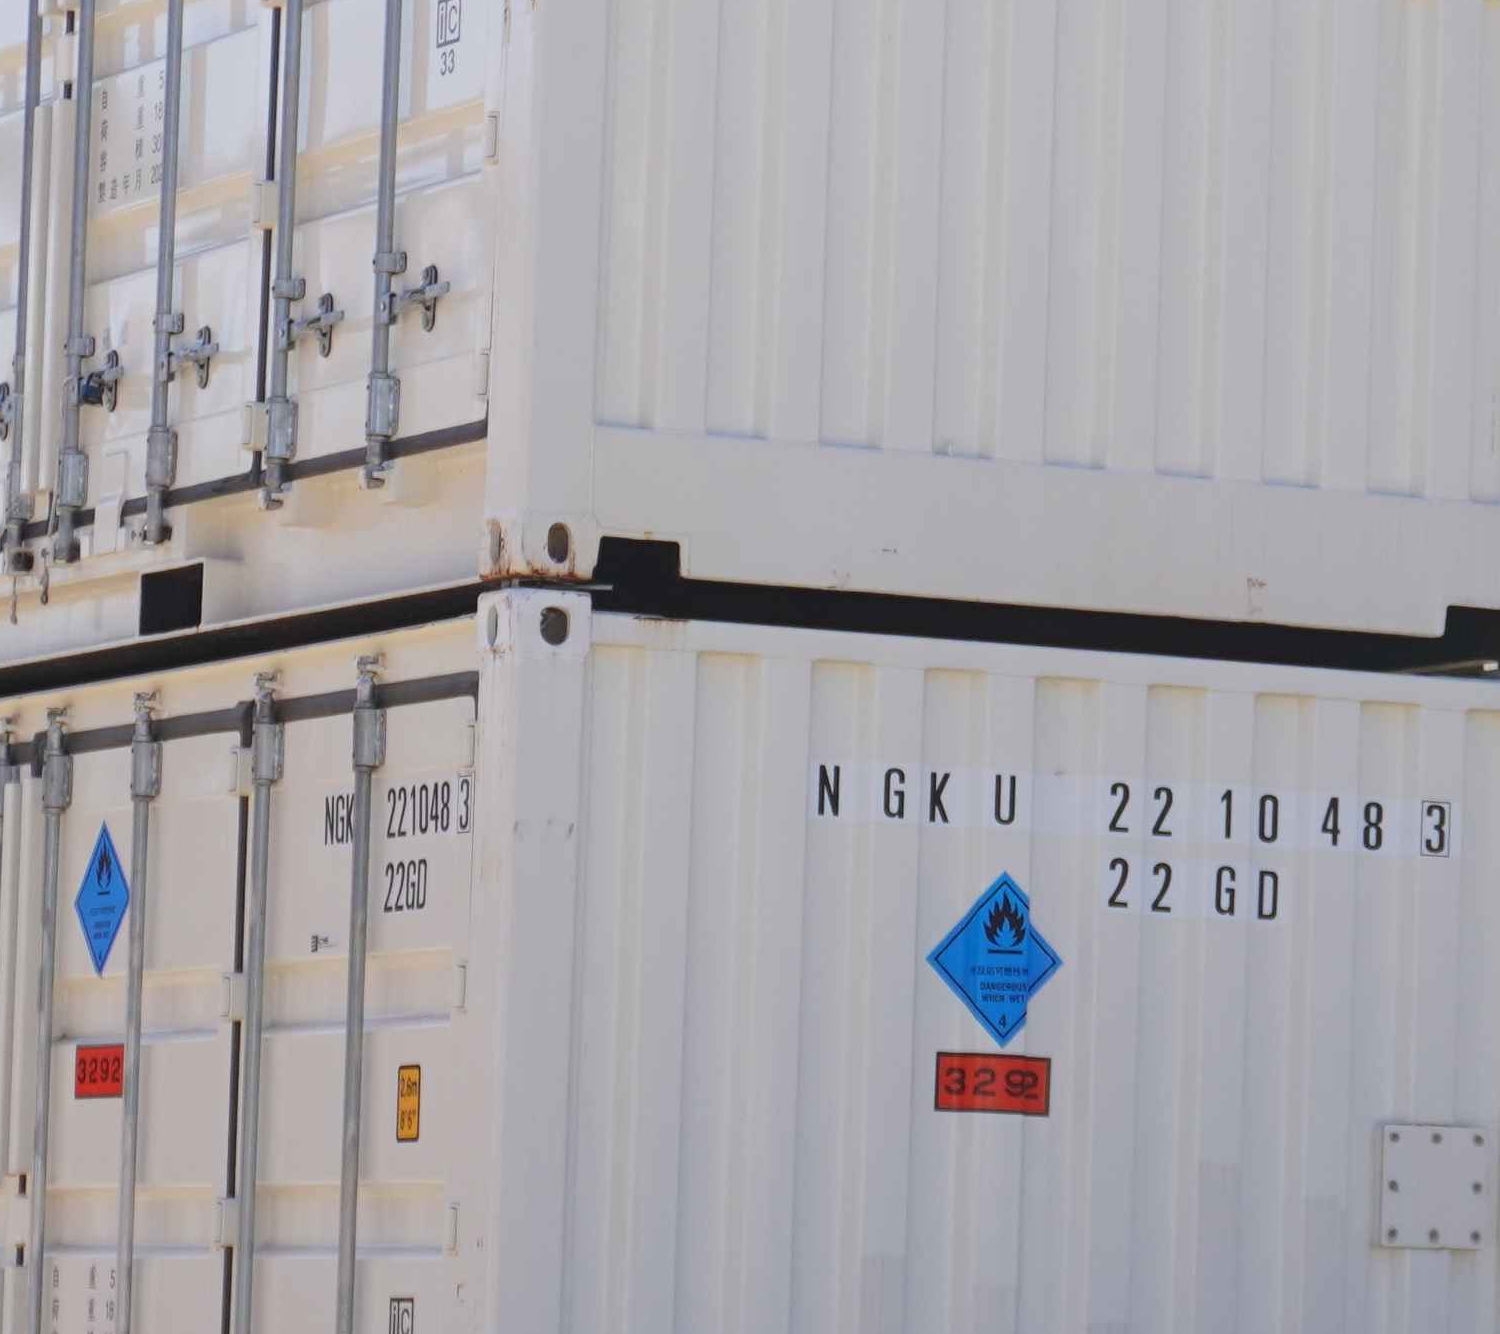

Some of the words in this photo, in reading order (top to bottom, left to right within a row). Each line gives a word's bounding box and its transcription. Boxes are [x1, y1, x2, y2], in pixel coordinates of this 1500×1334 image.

[440, 49, 455, 76] 33
[324, 793, 355, 846] NGK
[384, 858, 428, 913] 22GD
[998, 1014, 1007, 1028] 4
[77, 1056, 121, 1084] 3292
